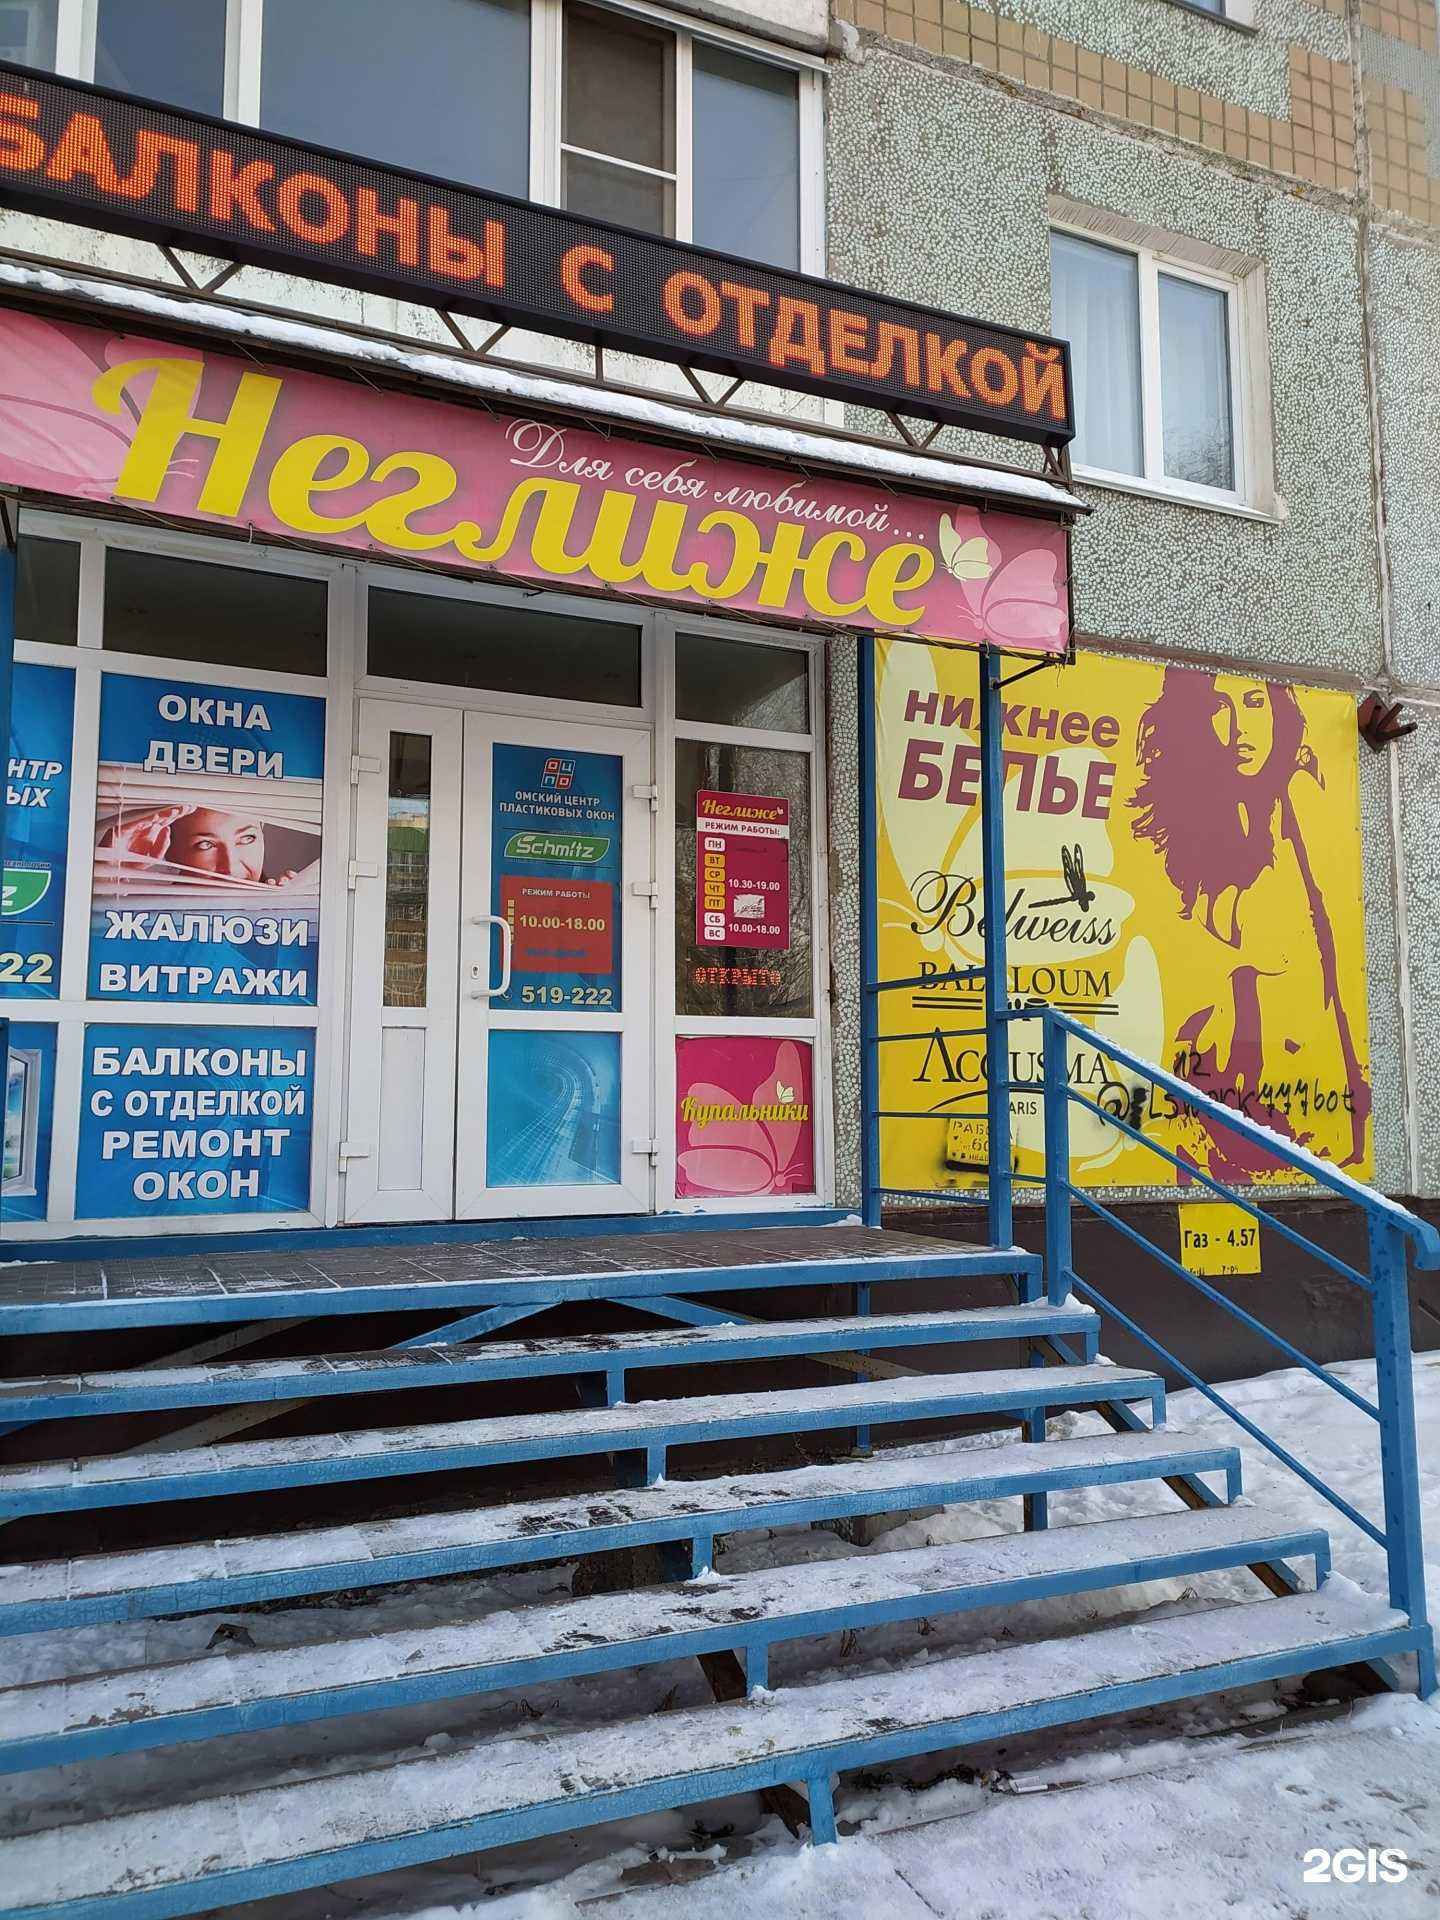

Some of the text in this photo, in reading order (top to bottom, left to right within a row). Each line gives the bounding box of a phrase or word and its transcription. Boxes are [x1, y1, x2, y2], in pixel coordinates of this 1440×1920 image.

[0, 92, 1067, 420] БАЛКОНЫ С ОТДЕЛКОЙ
[505, 418, 614, 482] Для
[625, 459, 708, 501] себя
[92, 358, 936, 626] Неглиже
[158, 694, 272, 731] ОКНА
[143, 740, 284, 779] ДВЕРИ
[898, 738, 1117, 820] БЕЛЬЕ
[515, 790, 600, 807] ОМСКИЙ ЦЕНТР
[500, 801, 615, 821] ПЛАСТИКОВЫХ ОКОН
[702, 799, 777, 820] Неглиже
[705, 821, 739, 832] РЕЖИМ
[516, 835, 594, 858] Schmitz
[708, 839, 722, 849] ПН
[709, 856, 721, 865] ВТ
[709, 870, 721, 879] СР
[728, 879, 780, 891] 10.30-19.00
[522, 888, 590, 899] РЕЖИМ РАБОТЫ
[709, 884, 721, 893] ЧТ
[104, 910, 309, 947] ЖАЛЮЗИ
[520, 914, 605, 931] 10.00-18.00
[709, 915, 721, 924] СБ
[728, 923, 780, 935] 10.00-18.00
[709, 929, 721, 938] ВС
[99, 964, 307, 997] ВИТРАЖИ
[918, 961, 1113, 998] BALLOUM
[521, 985, 613, 1006] 519-222
[93, 1047, 306, 1077] БАЛКОНЫ
[90, 1084, 305, 1120] С ОТДЕЛКОЙ
[681, 1096, 808, 1128] Купальники
[1009, 1101, 1038, 1115] ARIS
[102, 1129, 290, 1160] РЕМОНТ
[133, 1170, 260, 1201] ОКОН
[1184, 1230, 1208, 1248] Газ
[1227, 1228, 1256, 1247] 4.57
